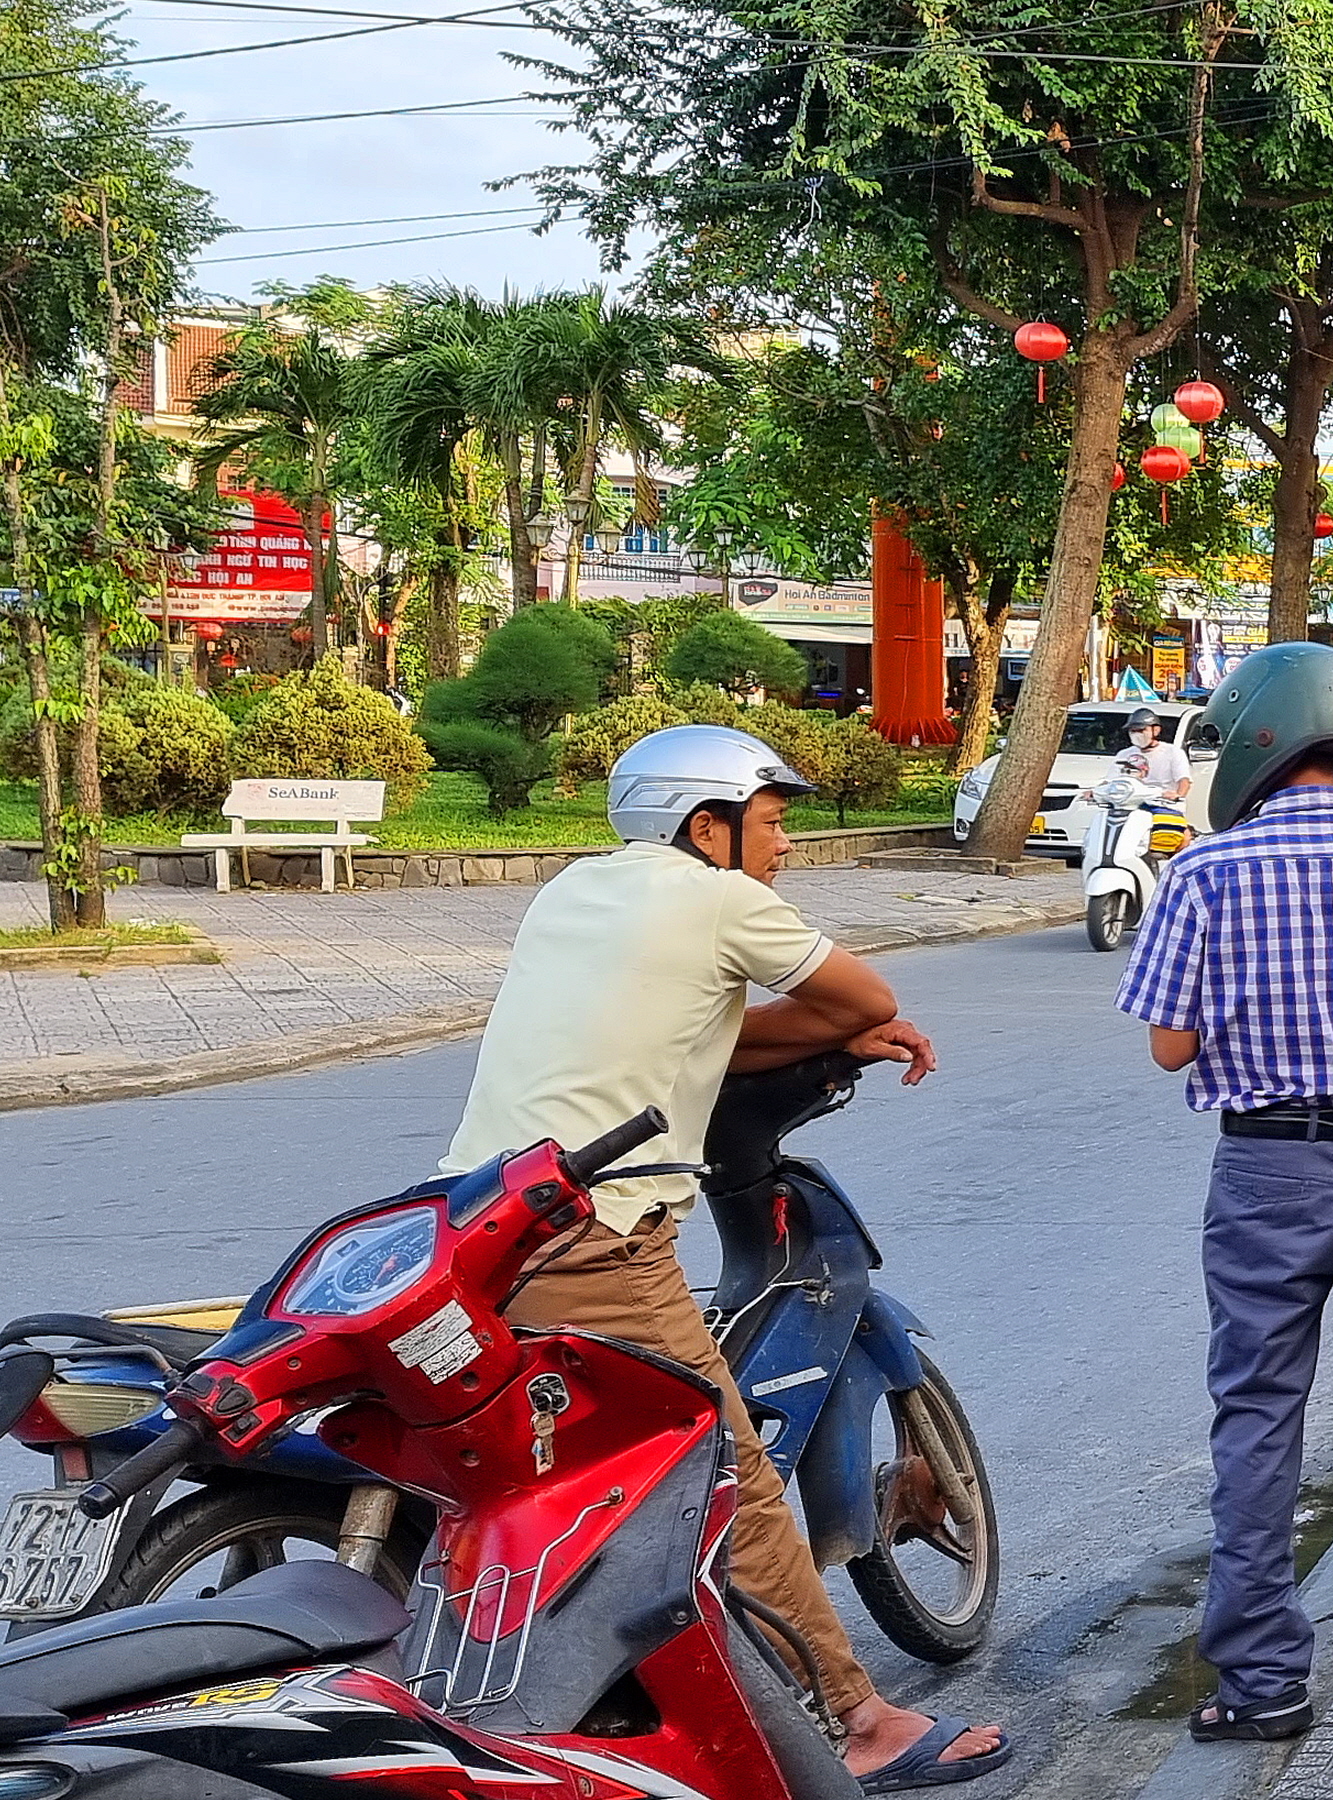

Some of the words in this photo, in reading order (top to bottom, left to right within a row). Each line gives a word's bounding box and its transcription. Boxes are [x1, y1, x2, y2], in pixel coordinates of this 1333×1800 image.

[803, 589, 817, 601] An
[818, 590, 870, 602] Badminton
[268, 787, 340, 800] SeABank
